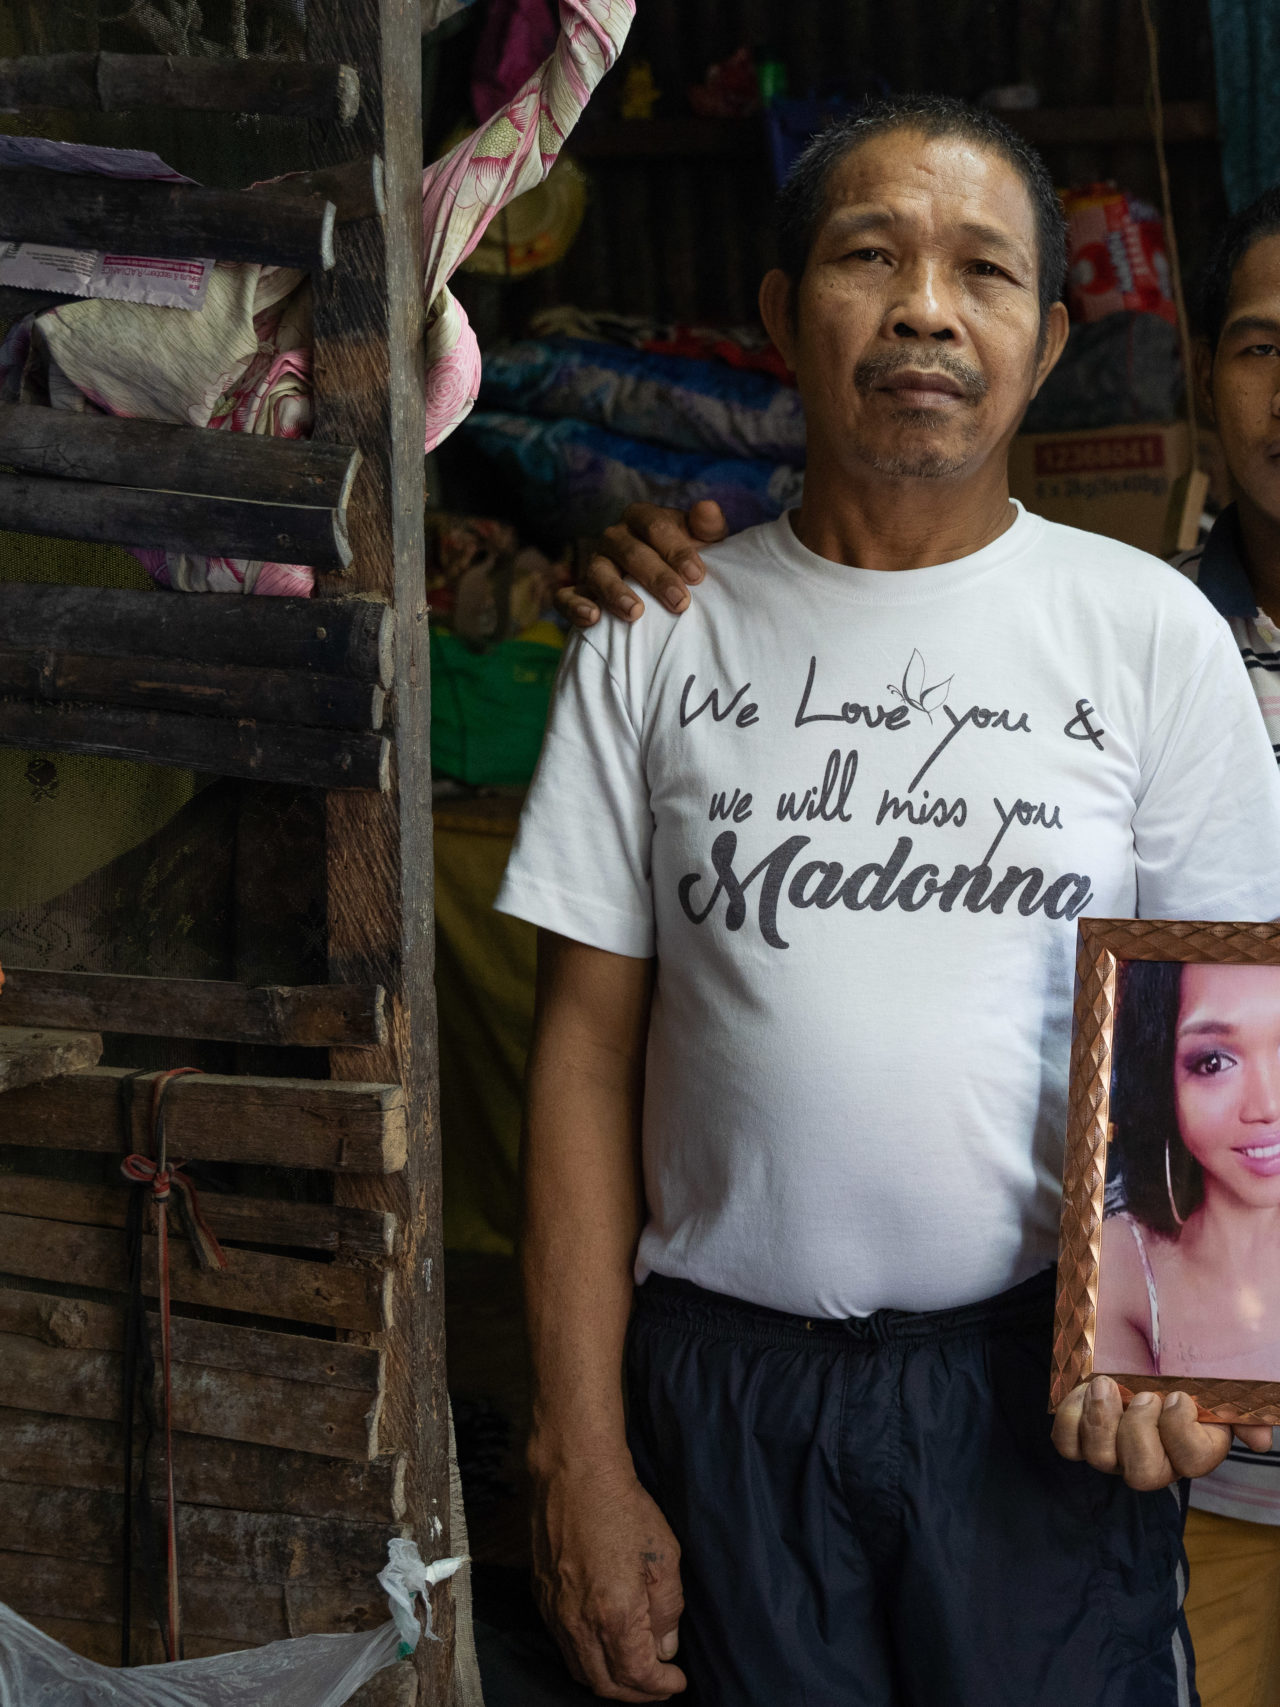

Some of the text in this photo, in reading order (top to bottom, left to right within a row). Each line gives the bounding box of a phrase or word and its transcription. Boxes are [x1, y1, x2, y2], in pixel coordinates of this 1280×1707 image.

[680, 656, 1105, 794] We Love you &
[708, 748, 1063, 867] we will miss you
[678, 830, 1094, 950] Madonna
